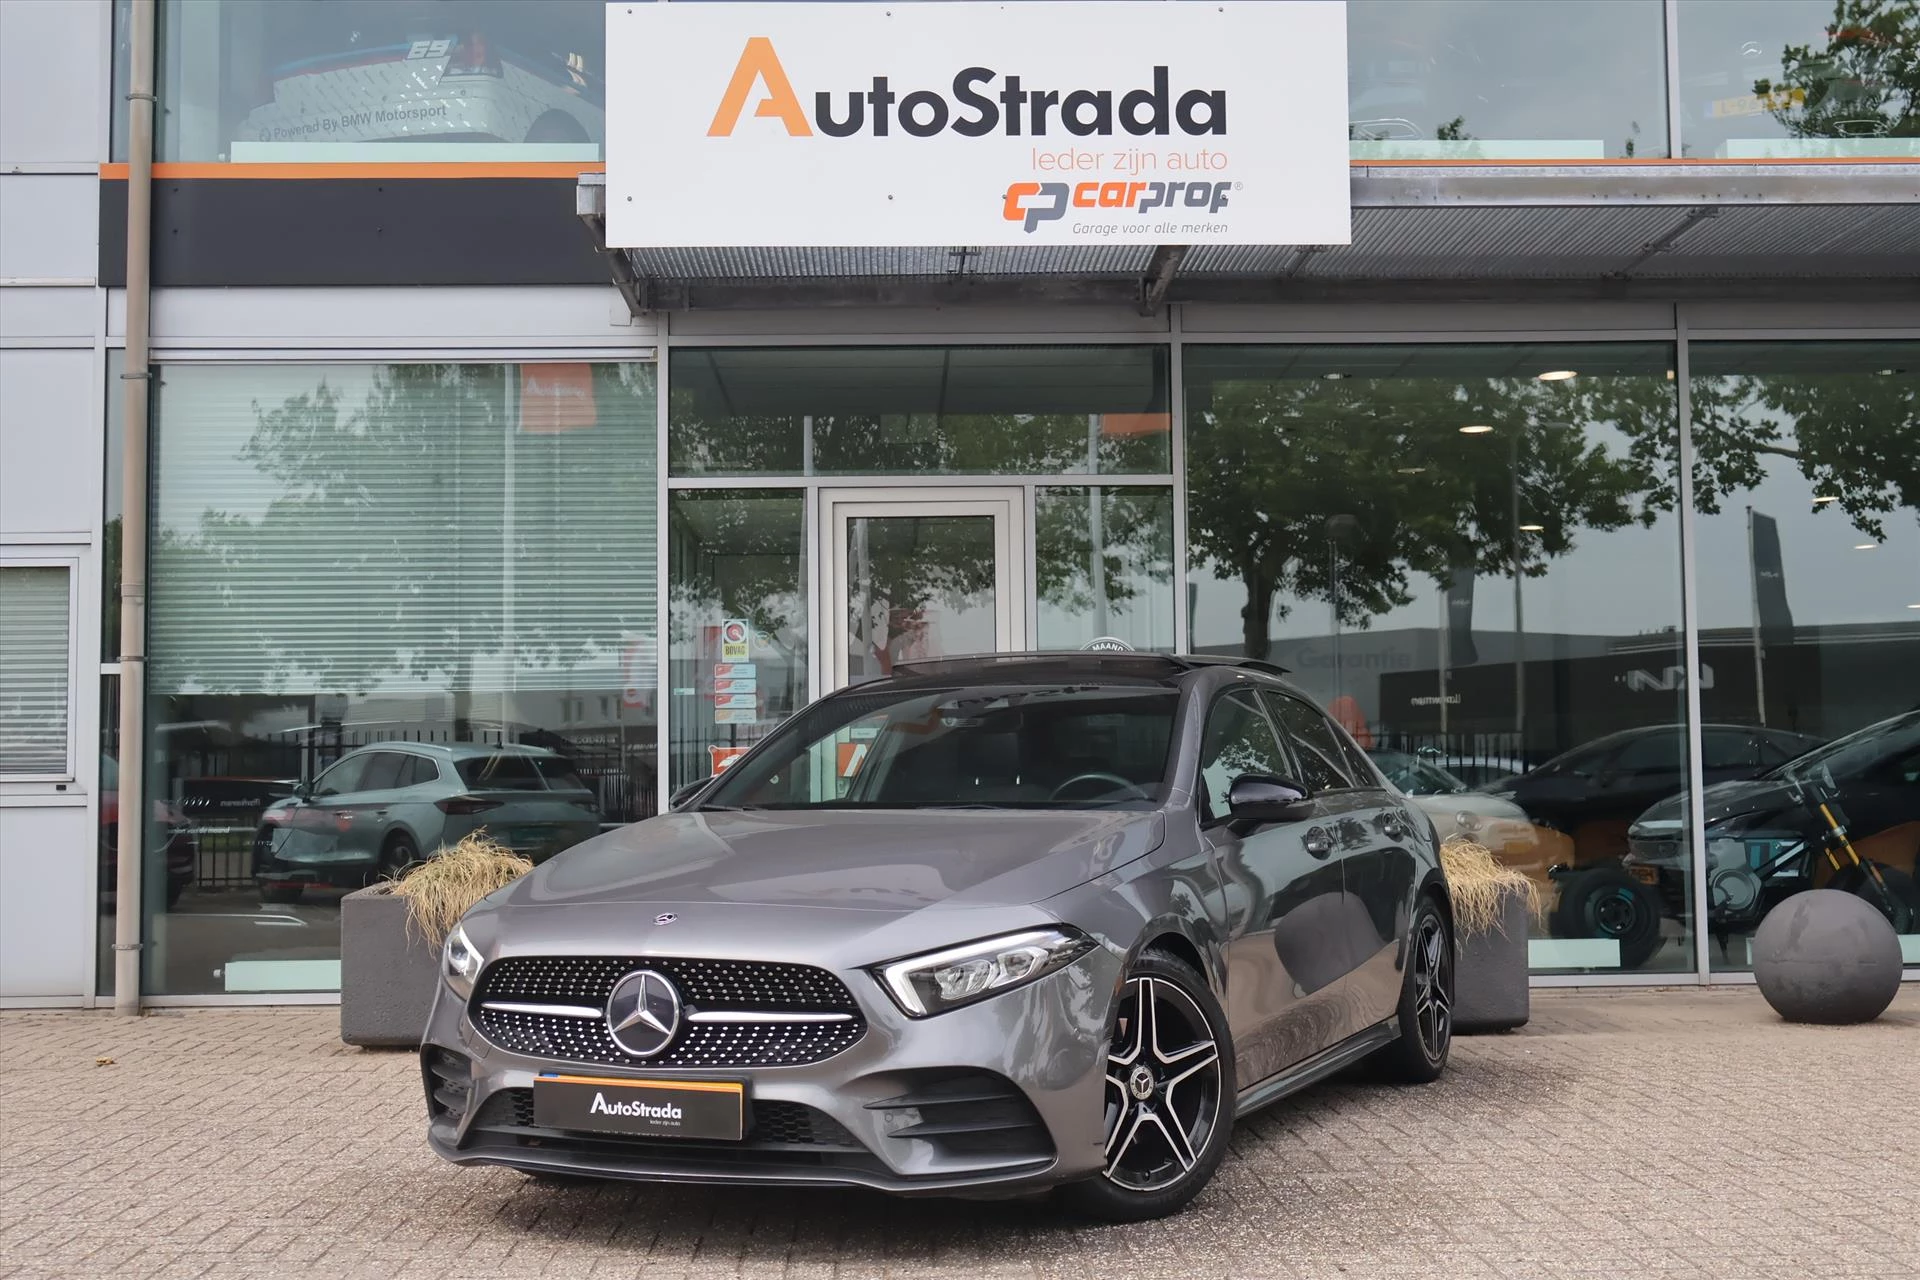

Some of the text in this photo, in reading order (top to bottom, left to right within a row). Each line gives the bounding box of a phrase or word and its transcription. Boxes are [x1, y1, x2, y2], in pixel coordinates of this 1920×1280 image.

[407, 40, 451, 59] 69
[706, 37, 1228, 138] AutoStrada
[274, 105, 447, 140] Powered By BMW Motorsport
[1032, 147, 1228, 176] Ieder zijn auto
[1072, 222, 1228, 237] Garage voor alle merken
[724, 645, 746, 656] BOVAG
[590, 1092, 682, 1119] AutoStrada
